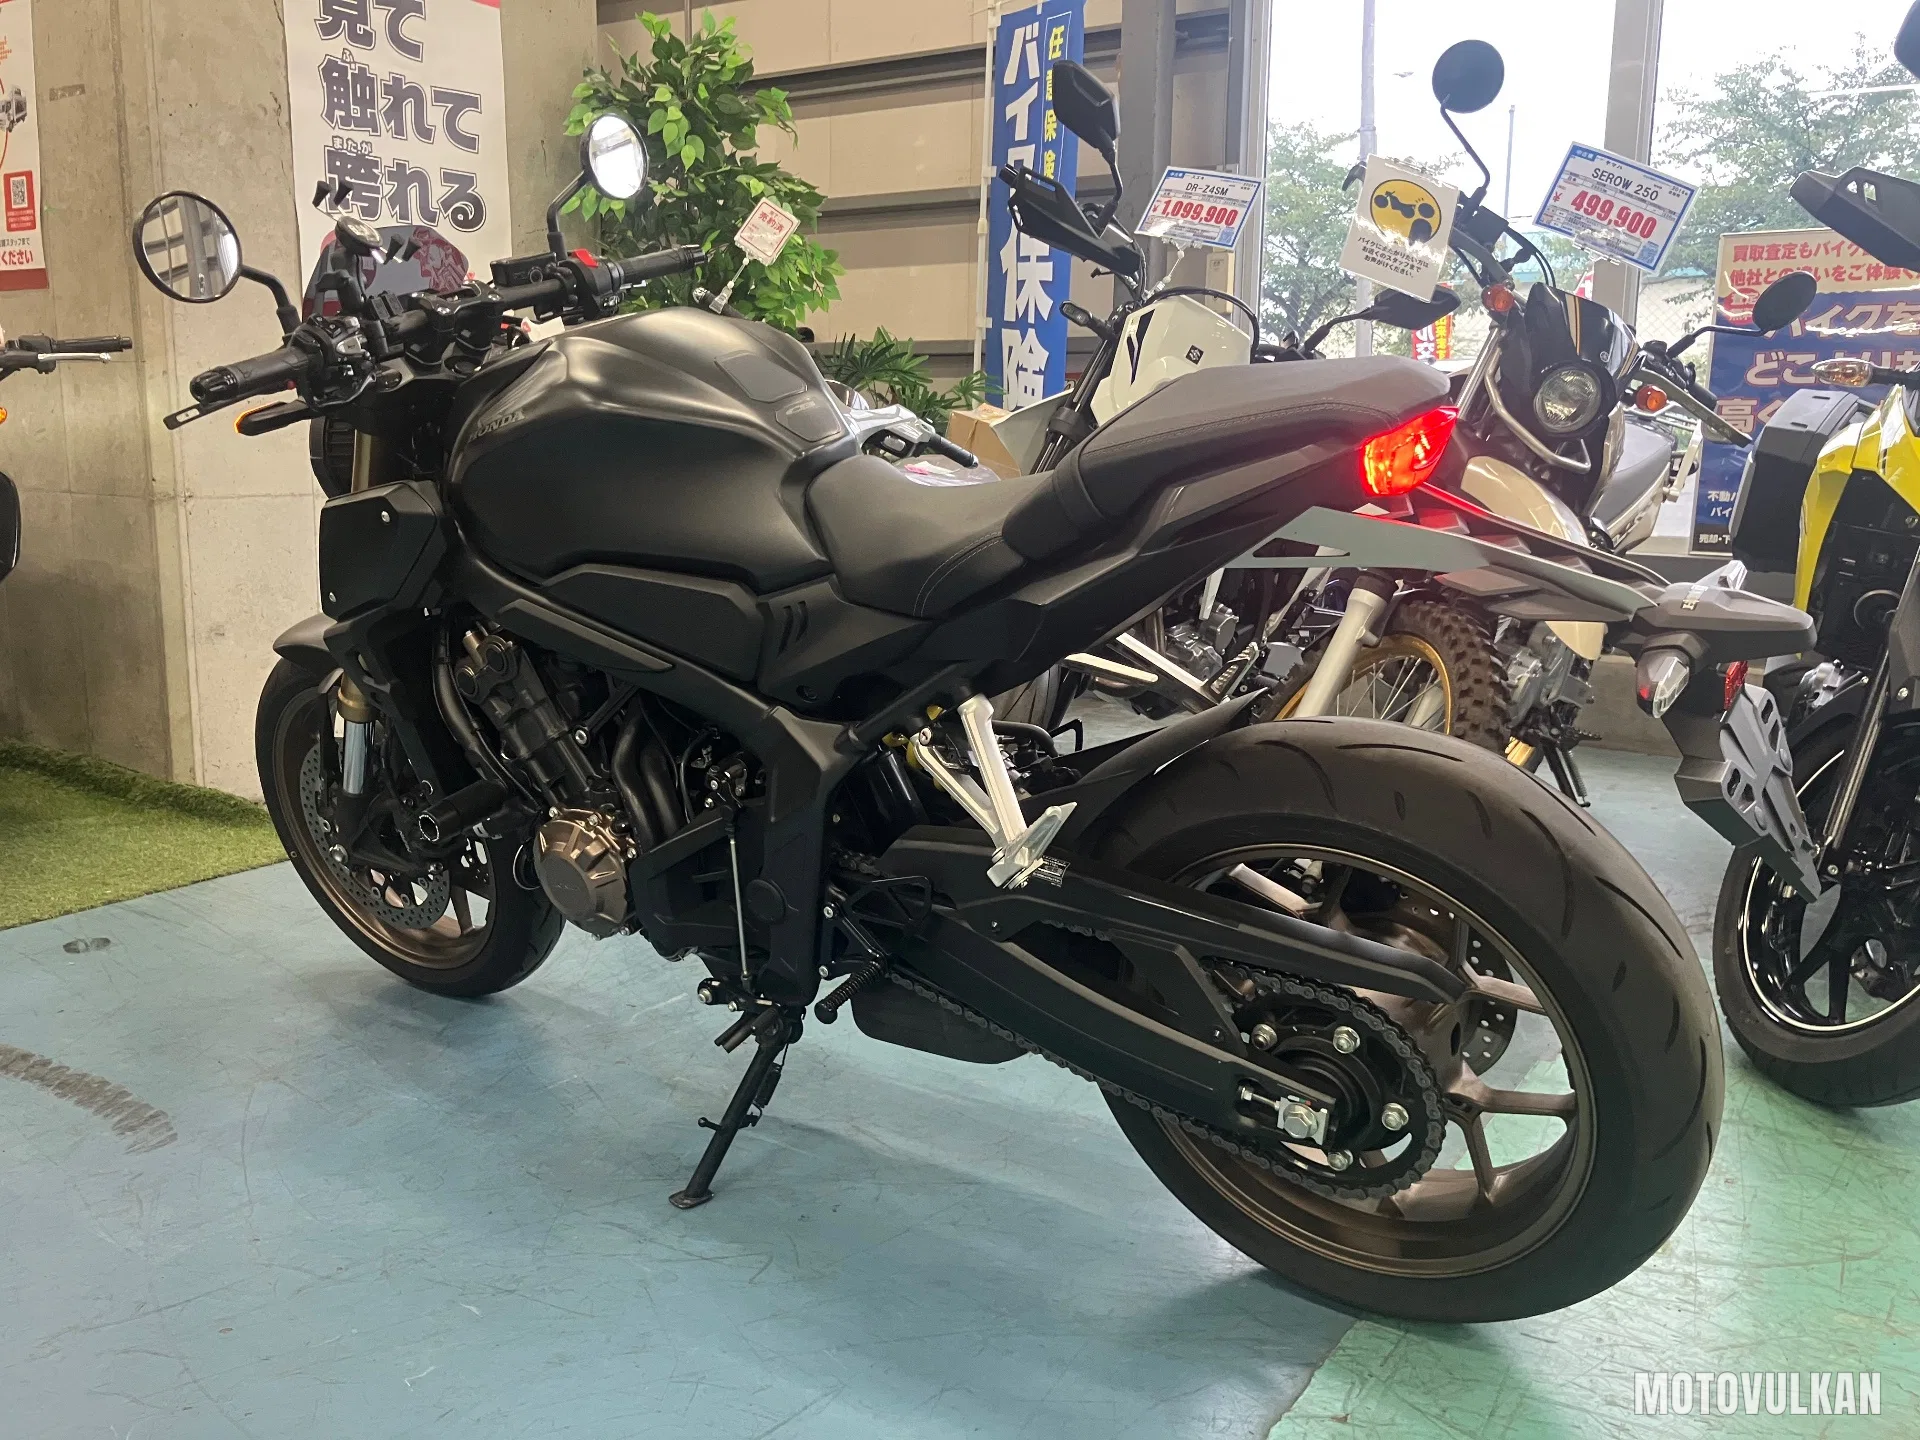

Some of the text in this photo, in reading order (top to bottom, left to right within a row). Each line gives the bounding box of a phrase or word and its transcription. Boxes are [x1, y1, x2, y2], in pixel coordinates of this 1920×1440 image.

[313, 0, 427, 62] 見て
[318, 54, 482, 154] 触れて
[324, 145, 486, 232] 跨れる
[1185, 182, 1229, 197] DR-Z4SM
[1591, 167, 1633, 191] SEROW
[1633, 184, 1659, 201] 250
[1161, 199, 1239, 227] 1,099,900
[1570, 189, 1658, 239] 499,900
[1357, 236, 1430, 269] バイクにまたがりたい方は
[1361, 245, 1423, 274] お近くのスタッフまで
[1363, 254, 1414, 279] お声がけください。
[1732, 239, 1879, 263] 買取査定もバイク
